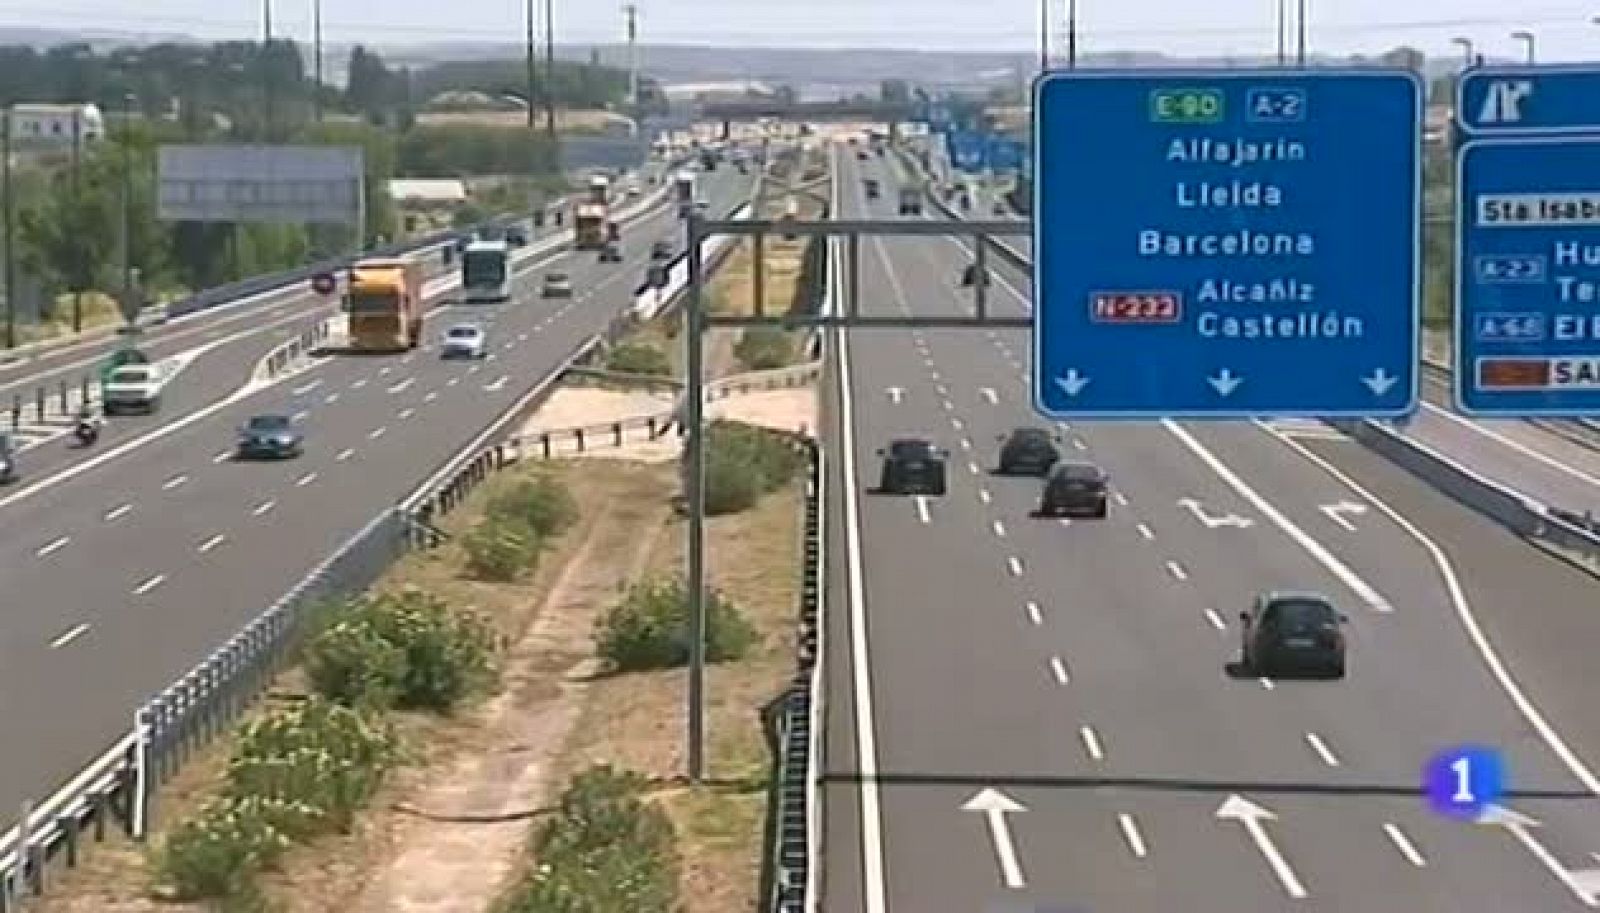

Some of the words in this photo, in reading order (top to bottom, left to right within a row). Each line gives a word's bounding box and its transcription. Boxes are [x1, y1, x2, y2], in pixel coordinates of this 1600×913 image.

[1256, 94, 1300, 116] A-2
[1176, 179, 1282, 207] Lleida
[1138, 228, 1315, 256] Barcelona
[1197, 278, 1315, 302] Alcañiz
[1197, 311, 1363, 338] Castellón
